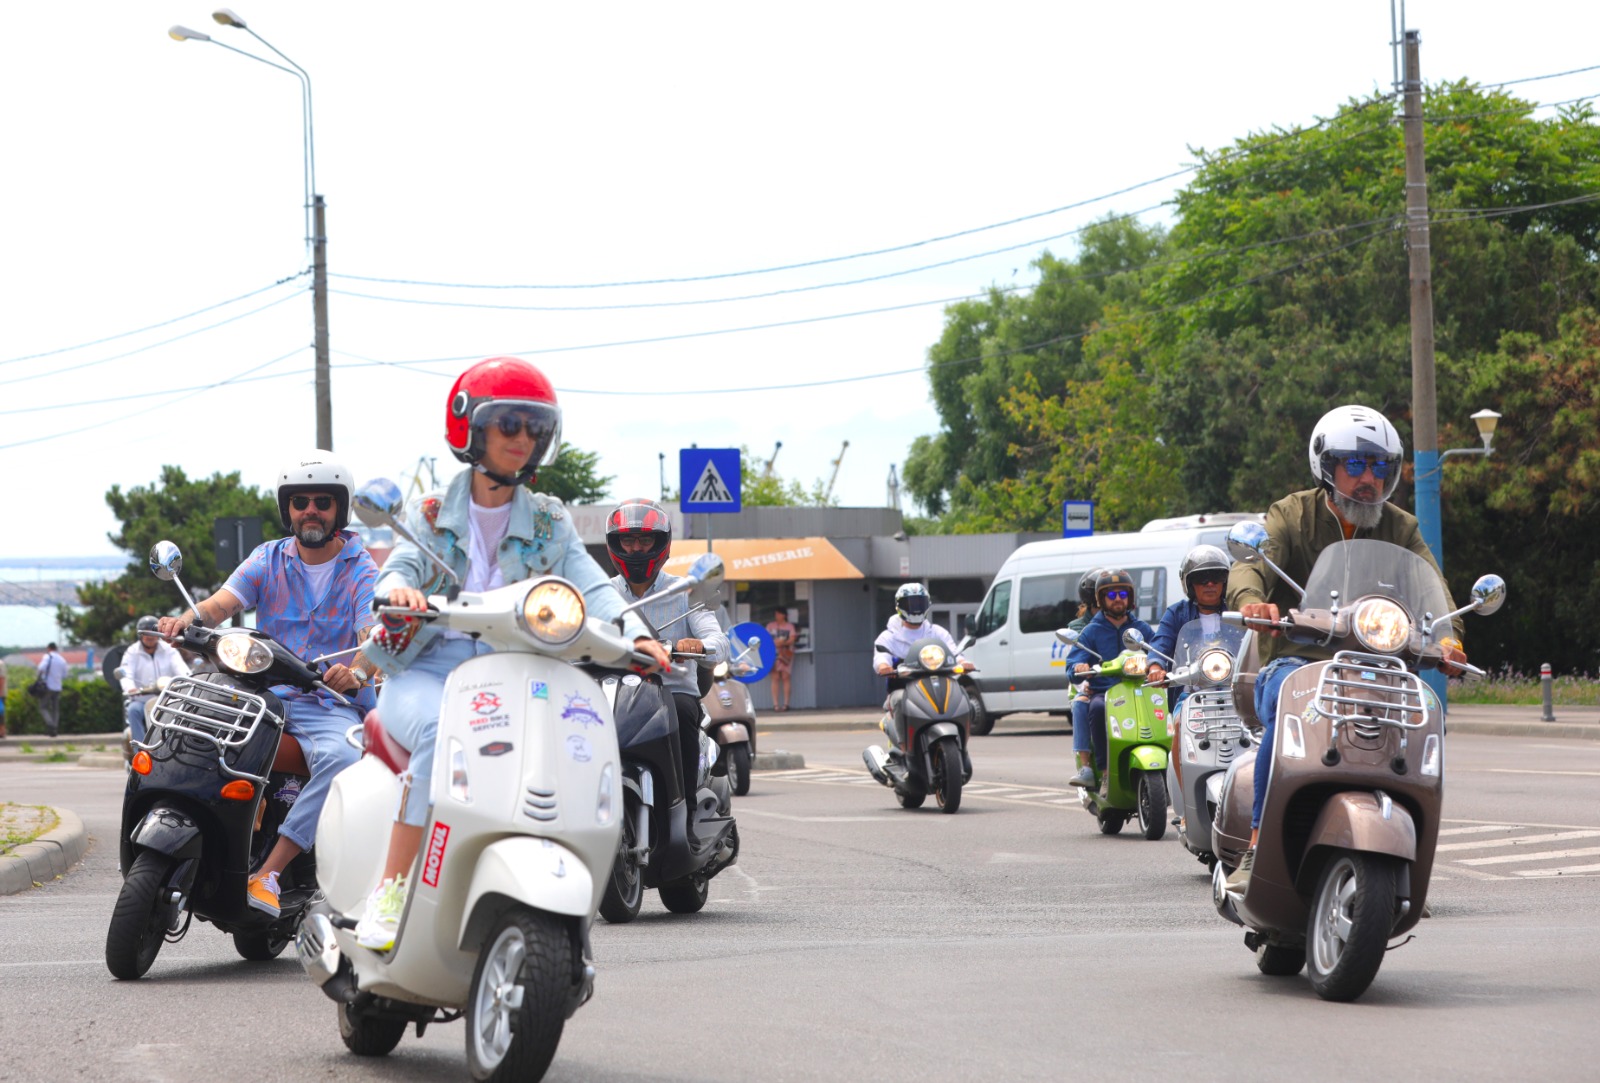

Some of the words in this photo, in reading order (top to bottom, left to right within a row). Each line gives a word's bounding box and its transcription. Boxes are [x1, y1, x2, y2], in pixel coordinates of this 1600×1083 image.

[732, 546, 815, 570] PATISERIE
[469, 717, 488, 726] RED
[490, 713, 510, 722] BIKE
[473, 722, 510, 732] SERVICE
[424, 827, 447, 884] MOTUL
